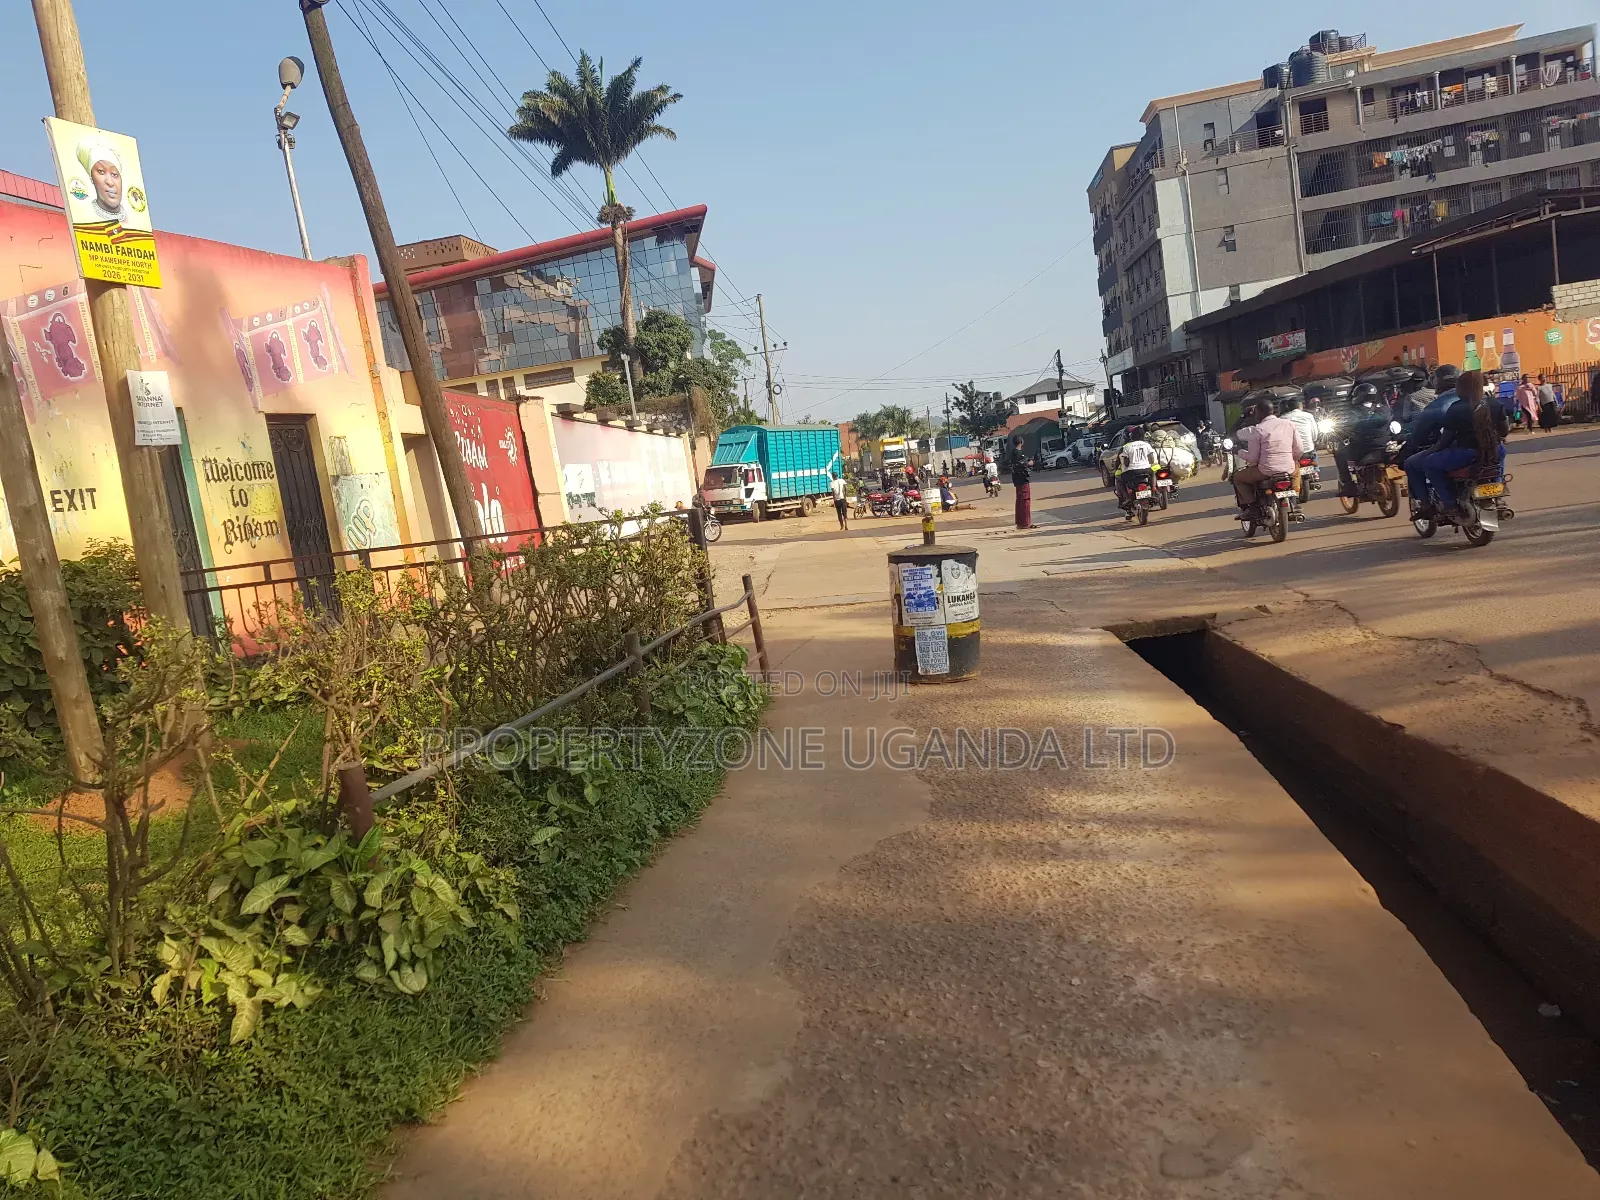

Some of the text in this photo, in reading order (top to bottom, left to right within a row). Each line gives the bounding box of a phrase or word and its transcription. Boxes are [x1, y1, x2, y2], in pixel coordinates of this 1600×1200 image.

[81, 240, 156, 260] NAMBI FARIDAH
[89, 253, 99, 261] MP
[131, 260, 153, 269] NORTH
[102, 269, 122, 279] 2026
[128, 273, 144, 282] 2031
[202, 456, 274, 483] Welcome
[50, 487, 97, 513] EXIT
[229, 484, 249, 508] to
[221, 515, 280, 554] Riham
